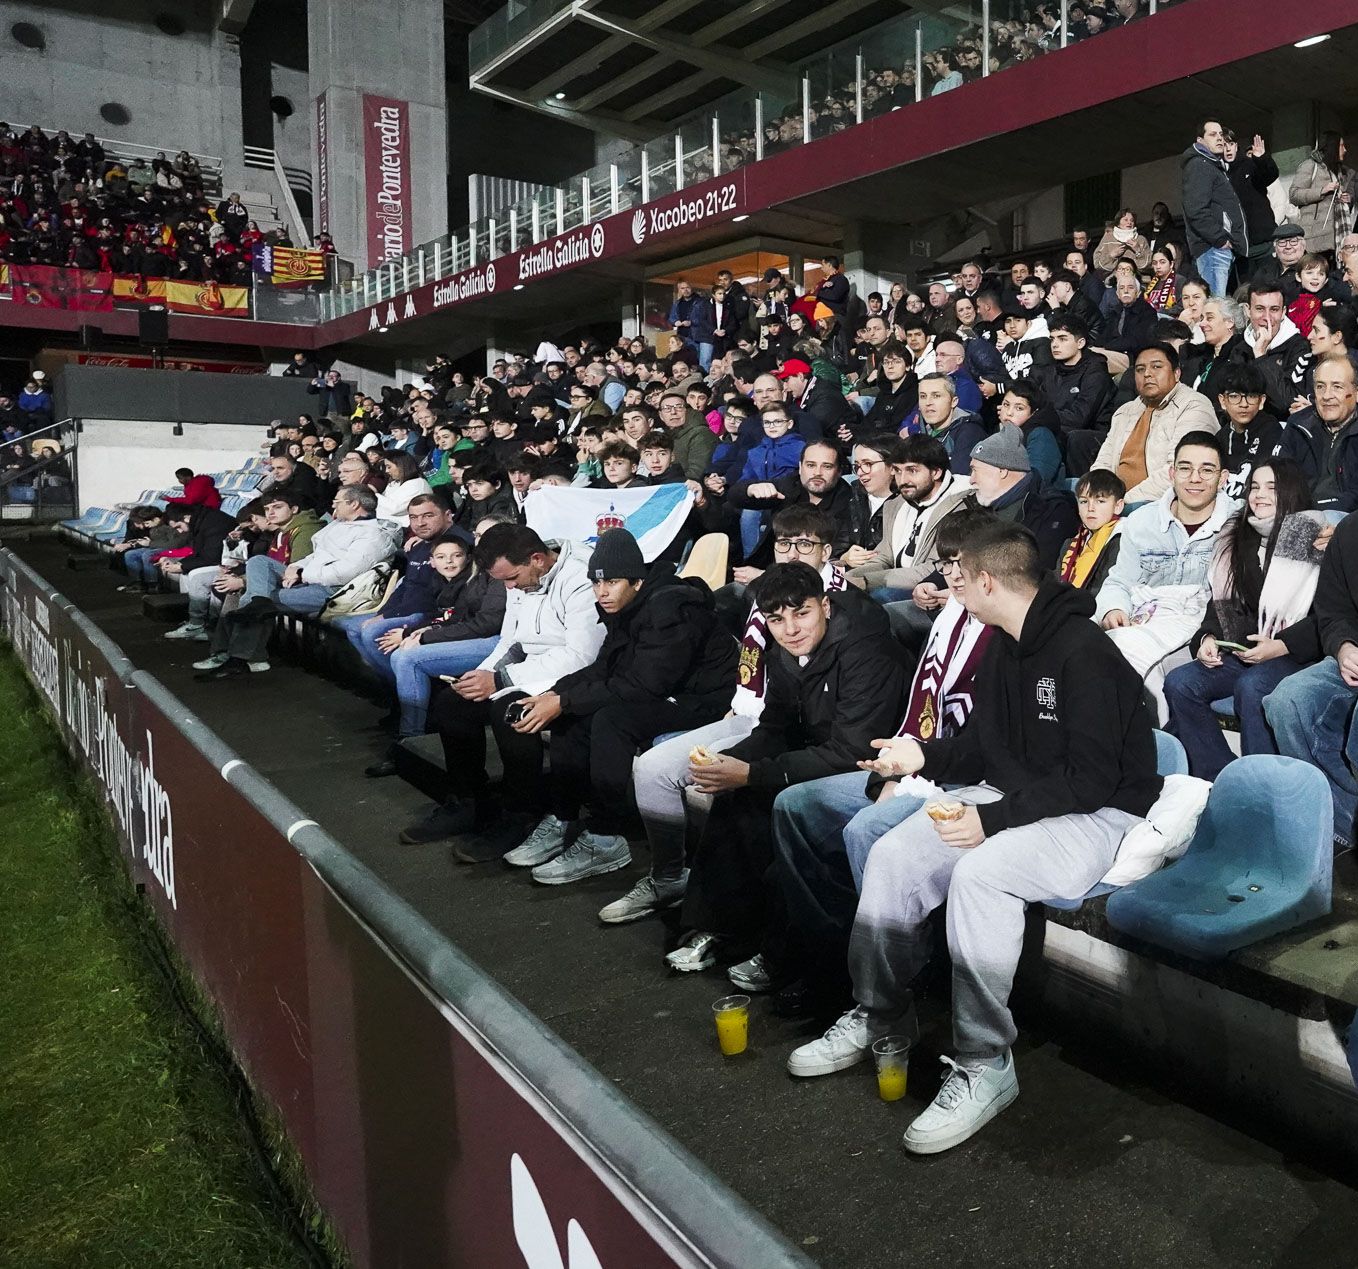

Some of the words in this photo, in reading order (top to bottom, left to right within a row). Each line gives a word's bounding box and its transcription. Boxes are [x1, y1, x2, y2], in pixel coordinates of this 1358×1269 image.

[650, 199, 704, 234] Xacobeo
[518, 247, 553, 279] Estrella
[554, 233, 590, 268] Galicia
[433, 281, 459, 307] Estrella
[459, 270, 485, 299] Galicia
